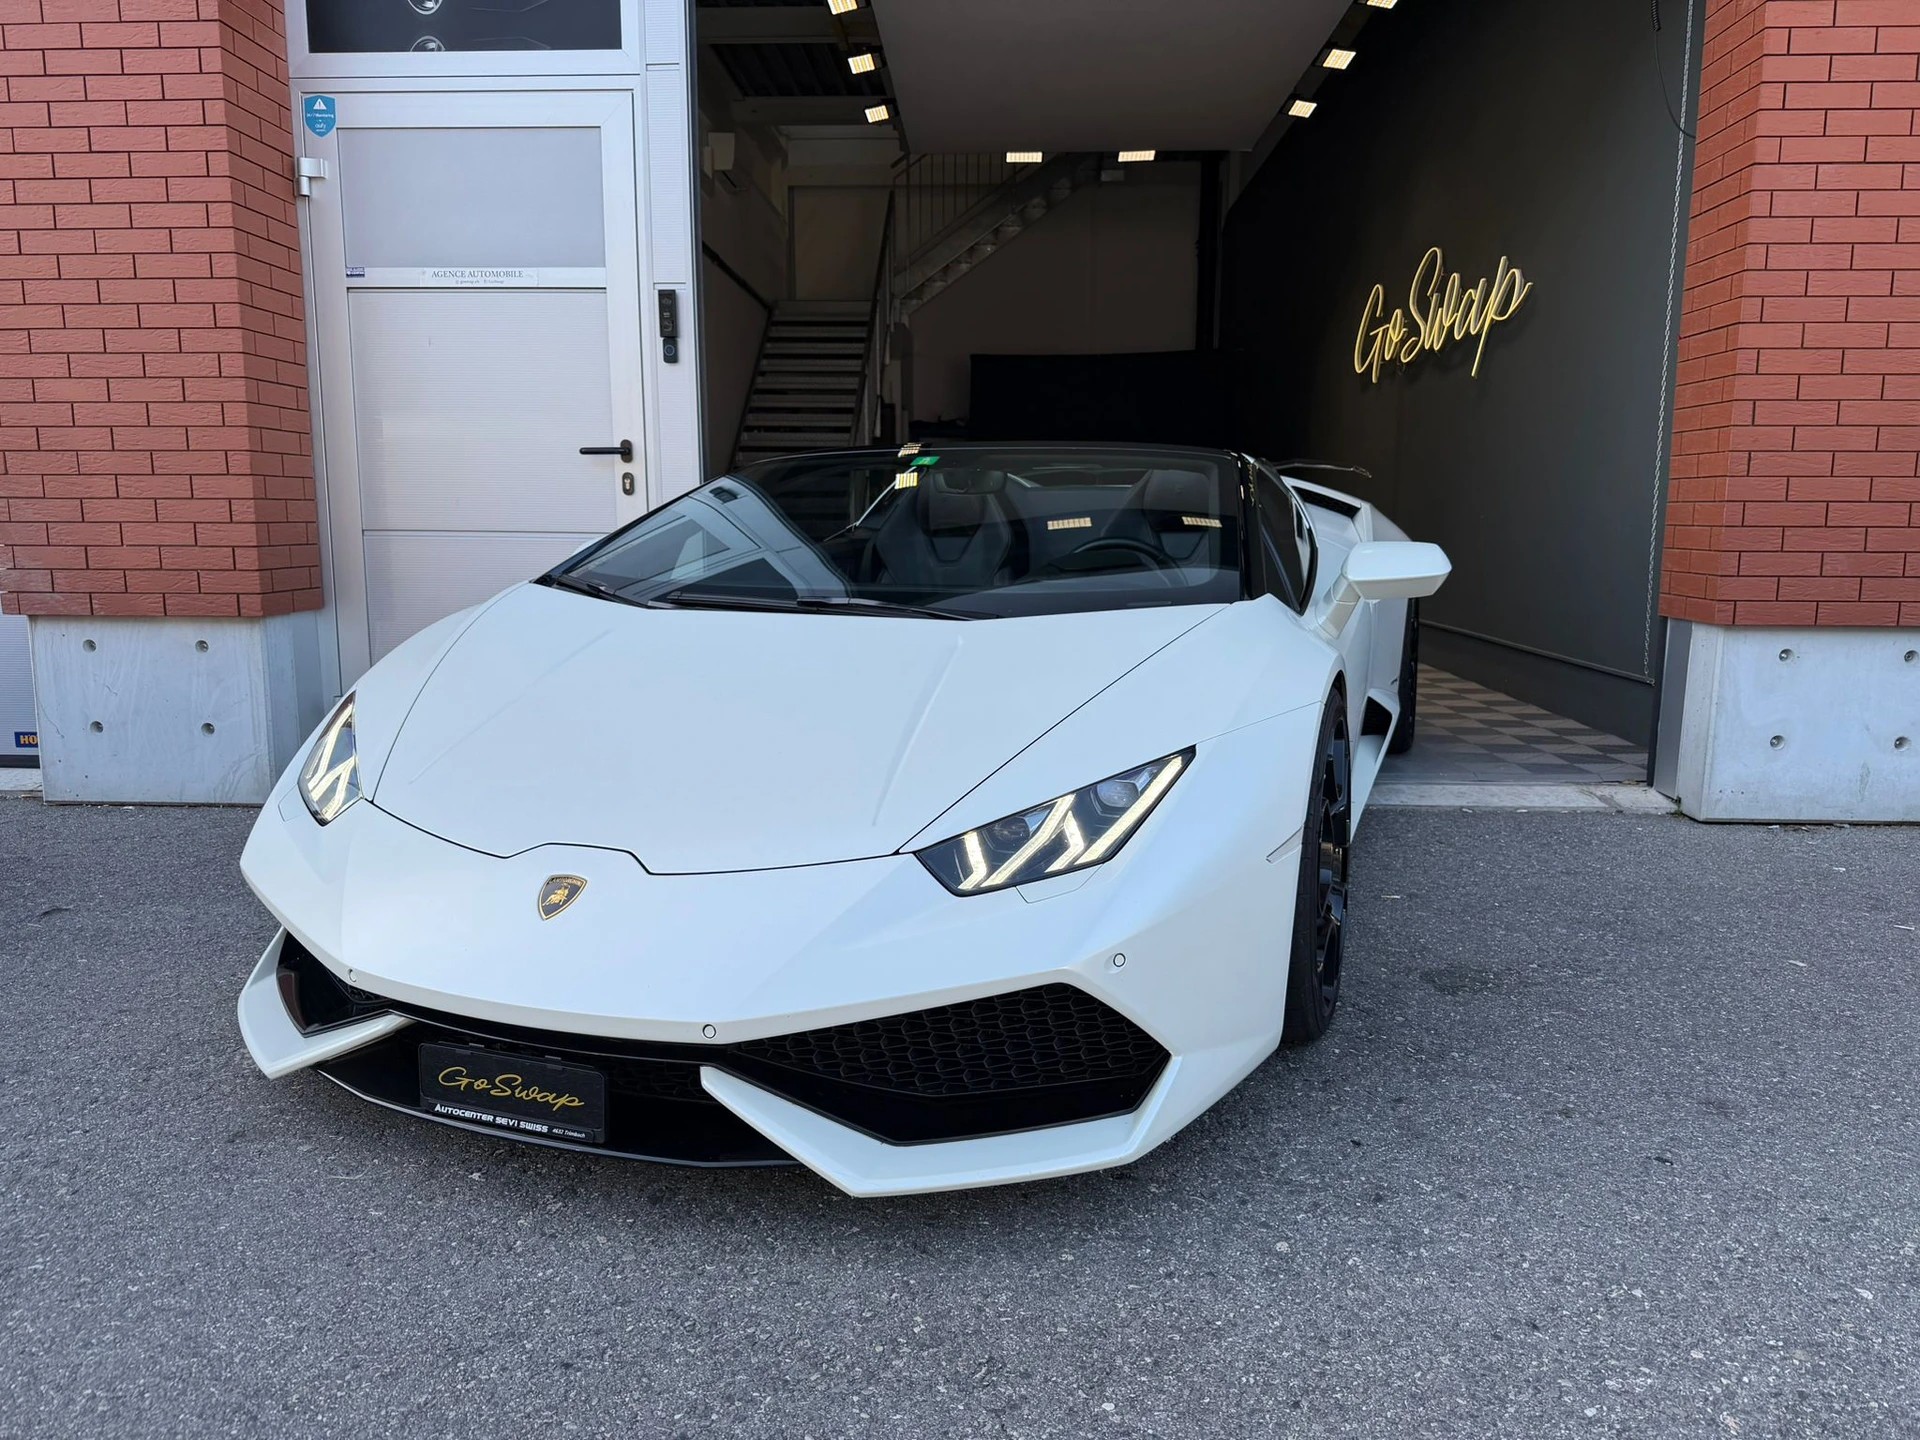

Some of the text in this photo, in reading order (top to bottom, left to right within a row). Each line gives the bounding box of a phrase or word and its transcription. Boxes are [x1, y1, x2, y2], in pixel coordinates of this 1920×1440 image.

[431, 270, 524, 278] AGENCE AUTOMOBILE
[495, 1116, 518, 1127] SEVI
[519, 1121, 549, 1133] SWISS
